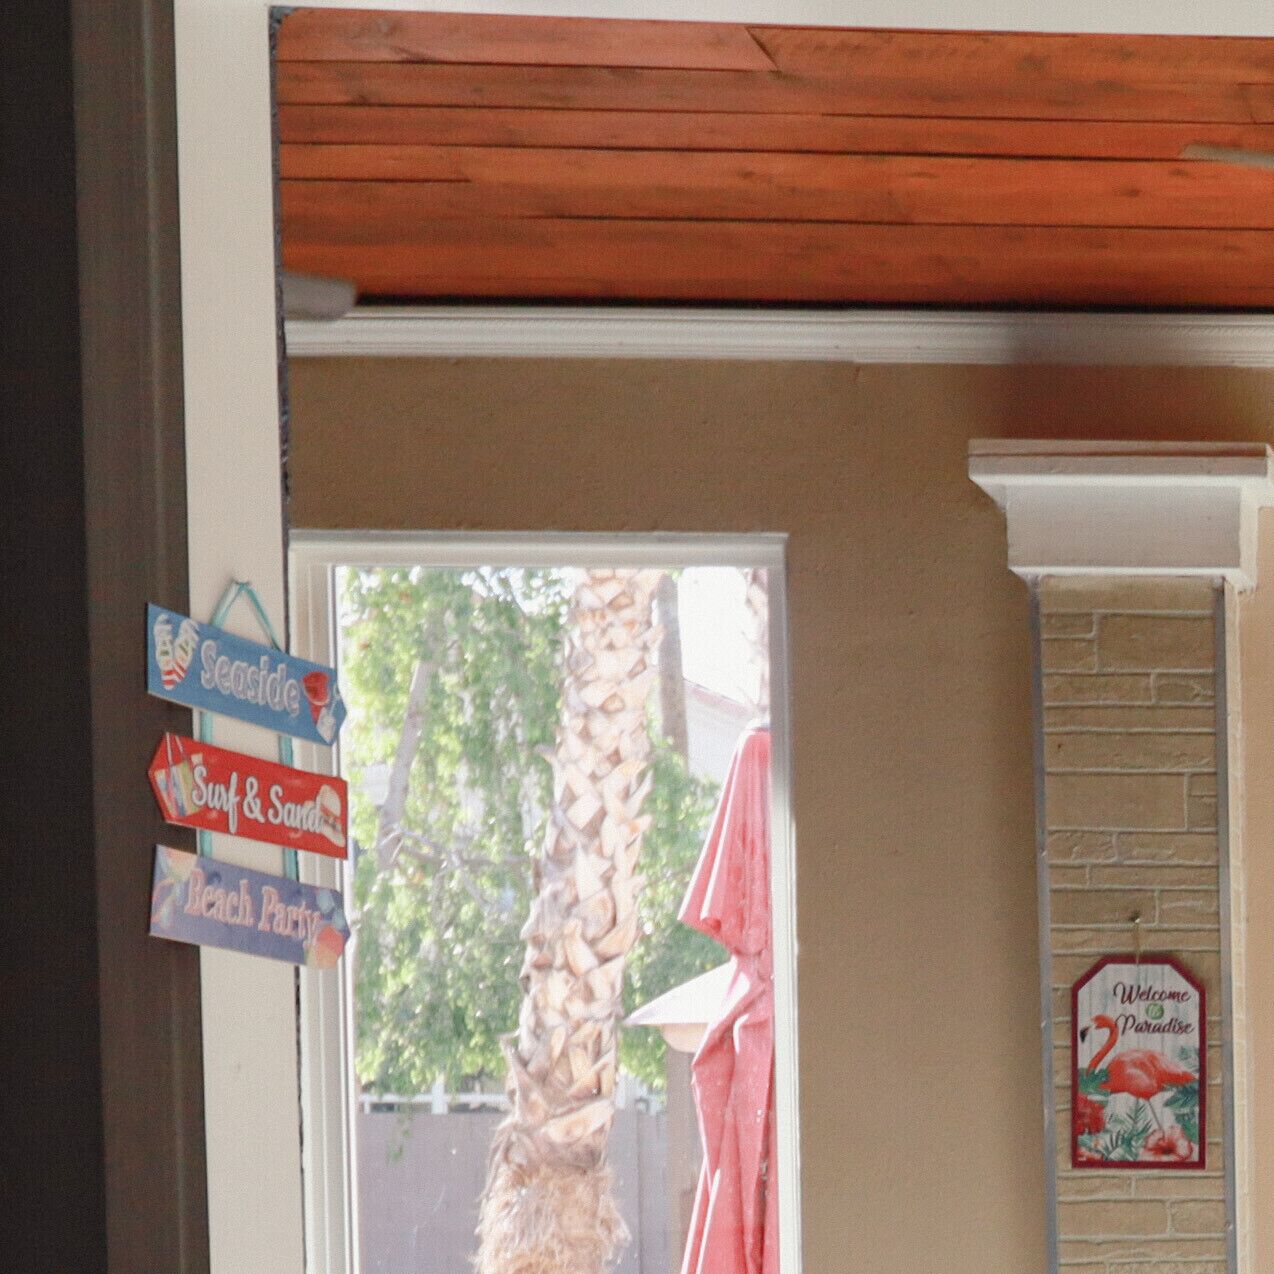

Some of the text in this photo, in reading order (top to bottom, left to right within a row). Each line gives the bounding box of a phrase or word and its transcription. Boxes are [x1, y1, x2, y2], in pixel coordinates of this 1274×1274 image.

[201, 640, 300, 716] Seaside
[192, 765, 325, 834] Surf & Sand
[185, 869, 323, 949] Beach Party
[1113, 982, 1191, 1005] Welcome
[1115, 1014, 1195, 1036] Paradise
